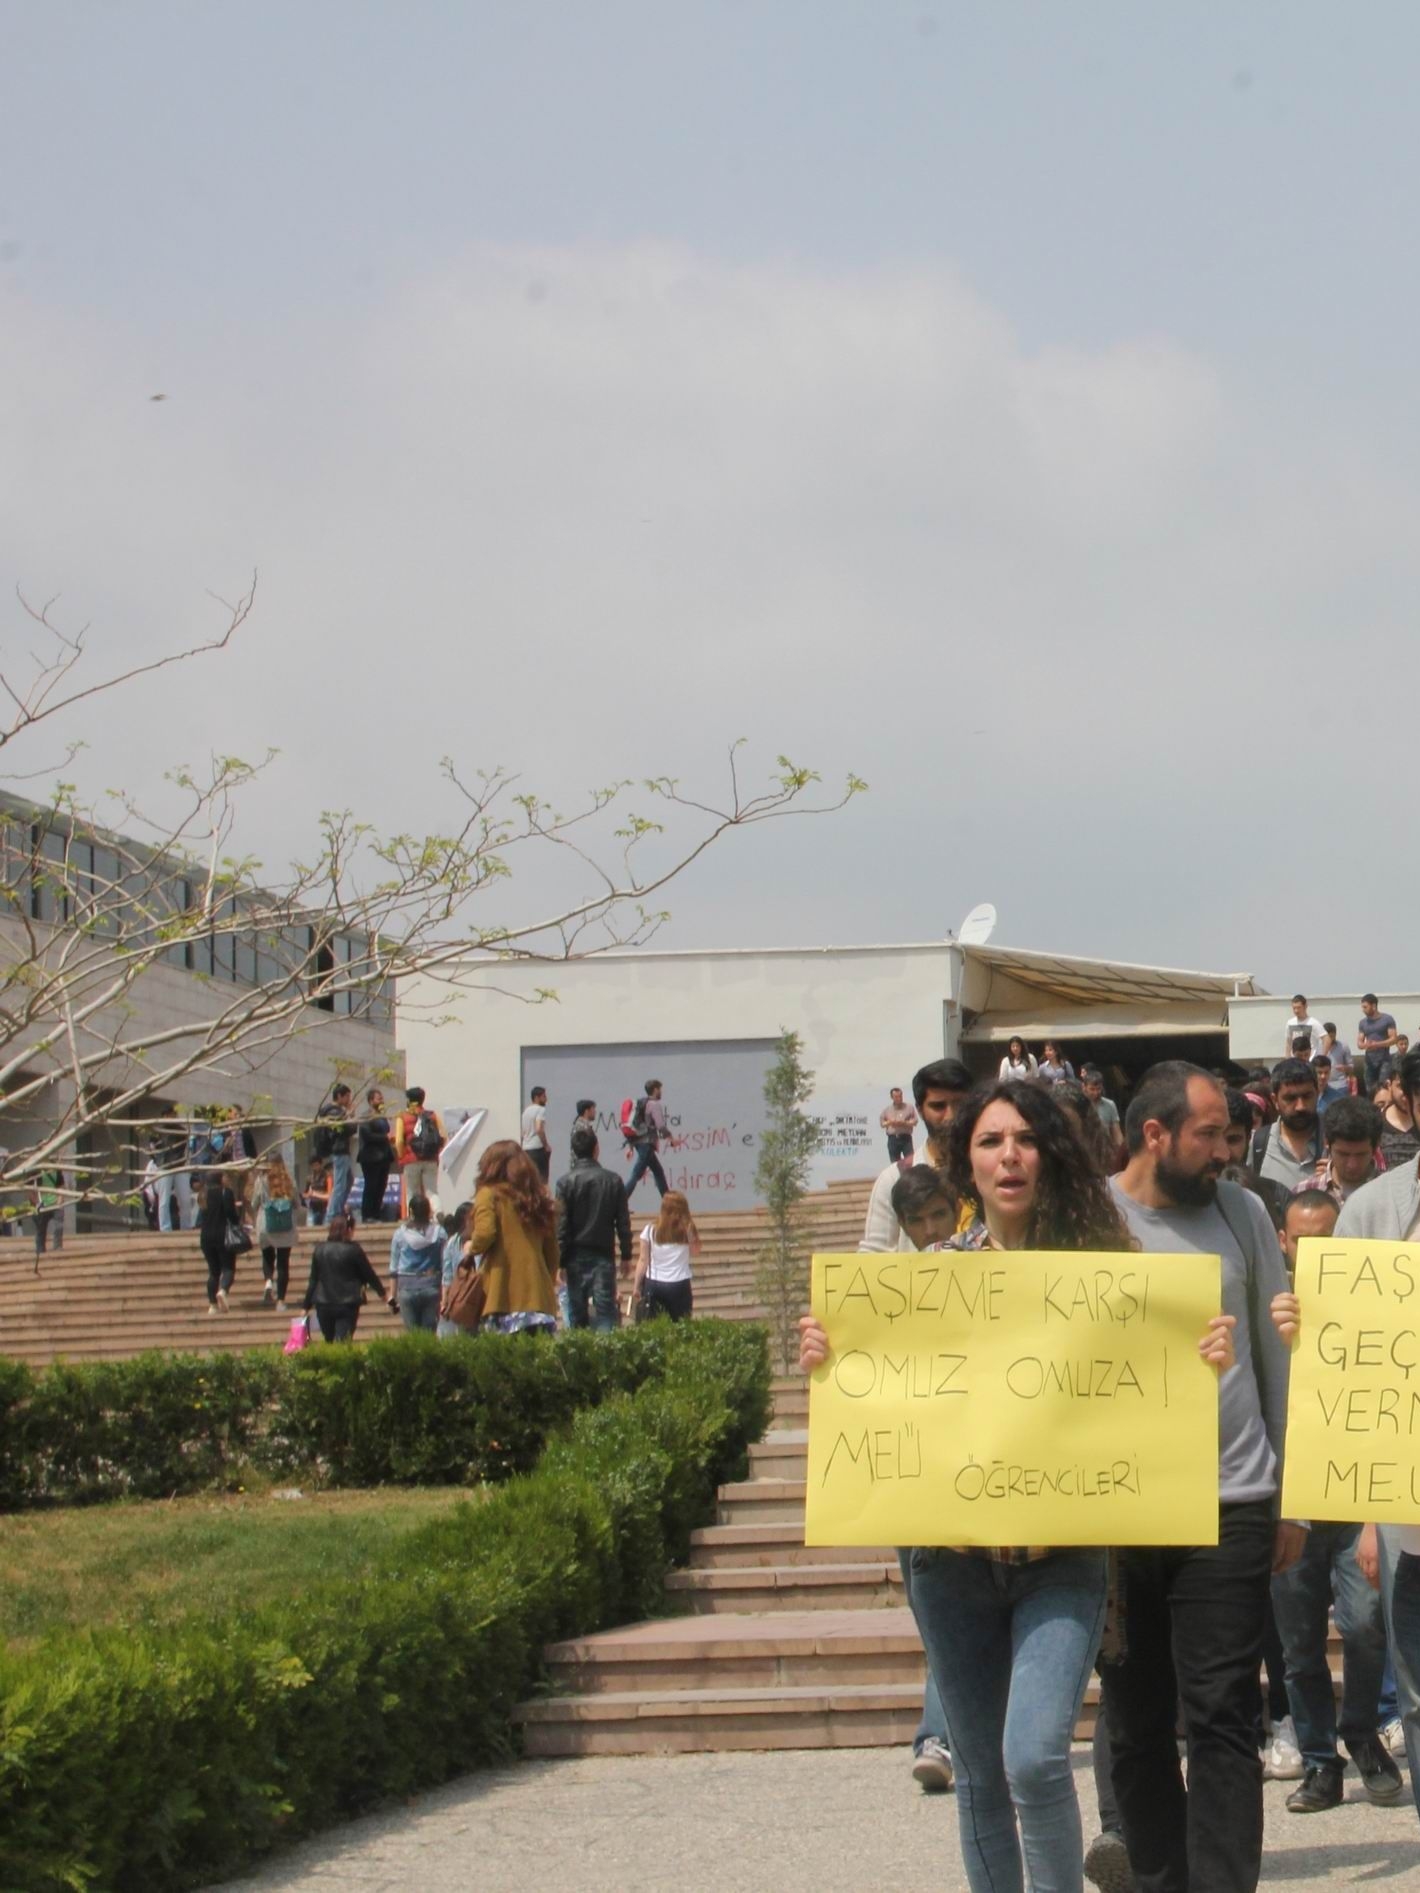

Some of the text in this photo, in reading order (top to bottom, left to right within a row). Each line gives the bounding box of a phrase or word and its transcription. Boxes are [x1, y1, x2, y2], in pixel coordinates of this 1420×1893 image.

[824, 1261, 1150, 1328] FAŞİZME KARŞI
[834, 1349, 969, 1399] OMUZ
[821, 1422, 1142, 1501] MEÜ ÖĞRENCİLERİ
